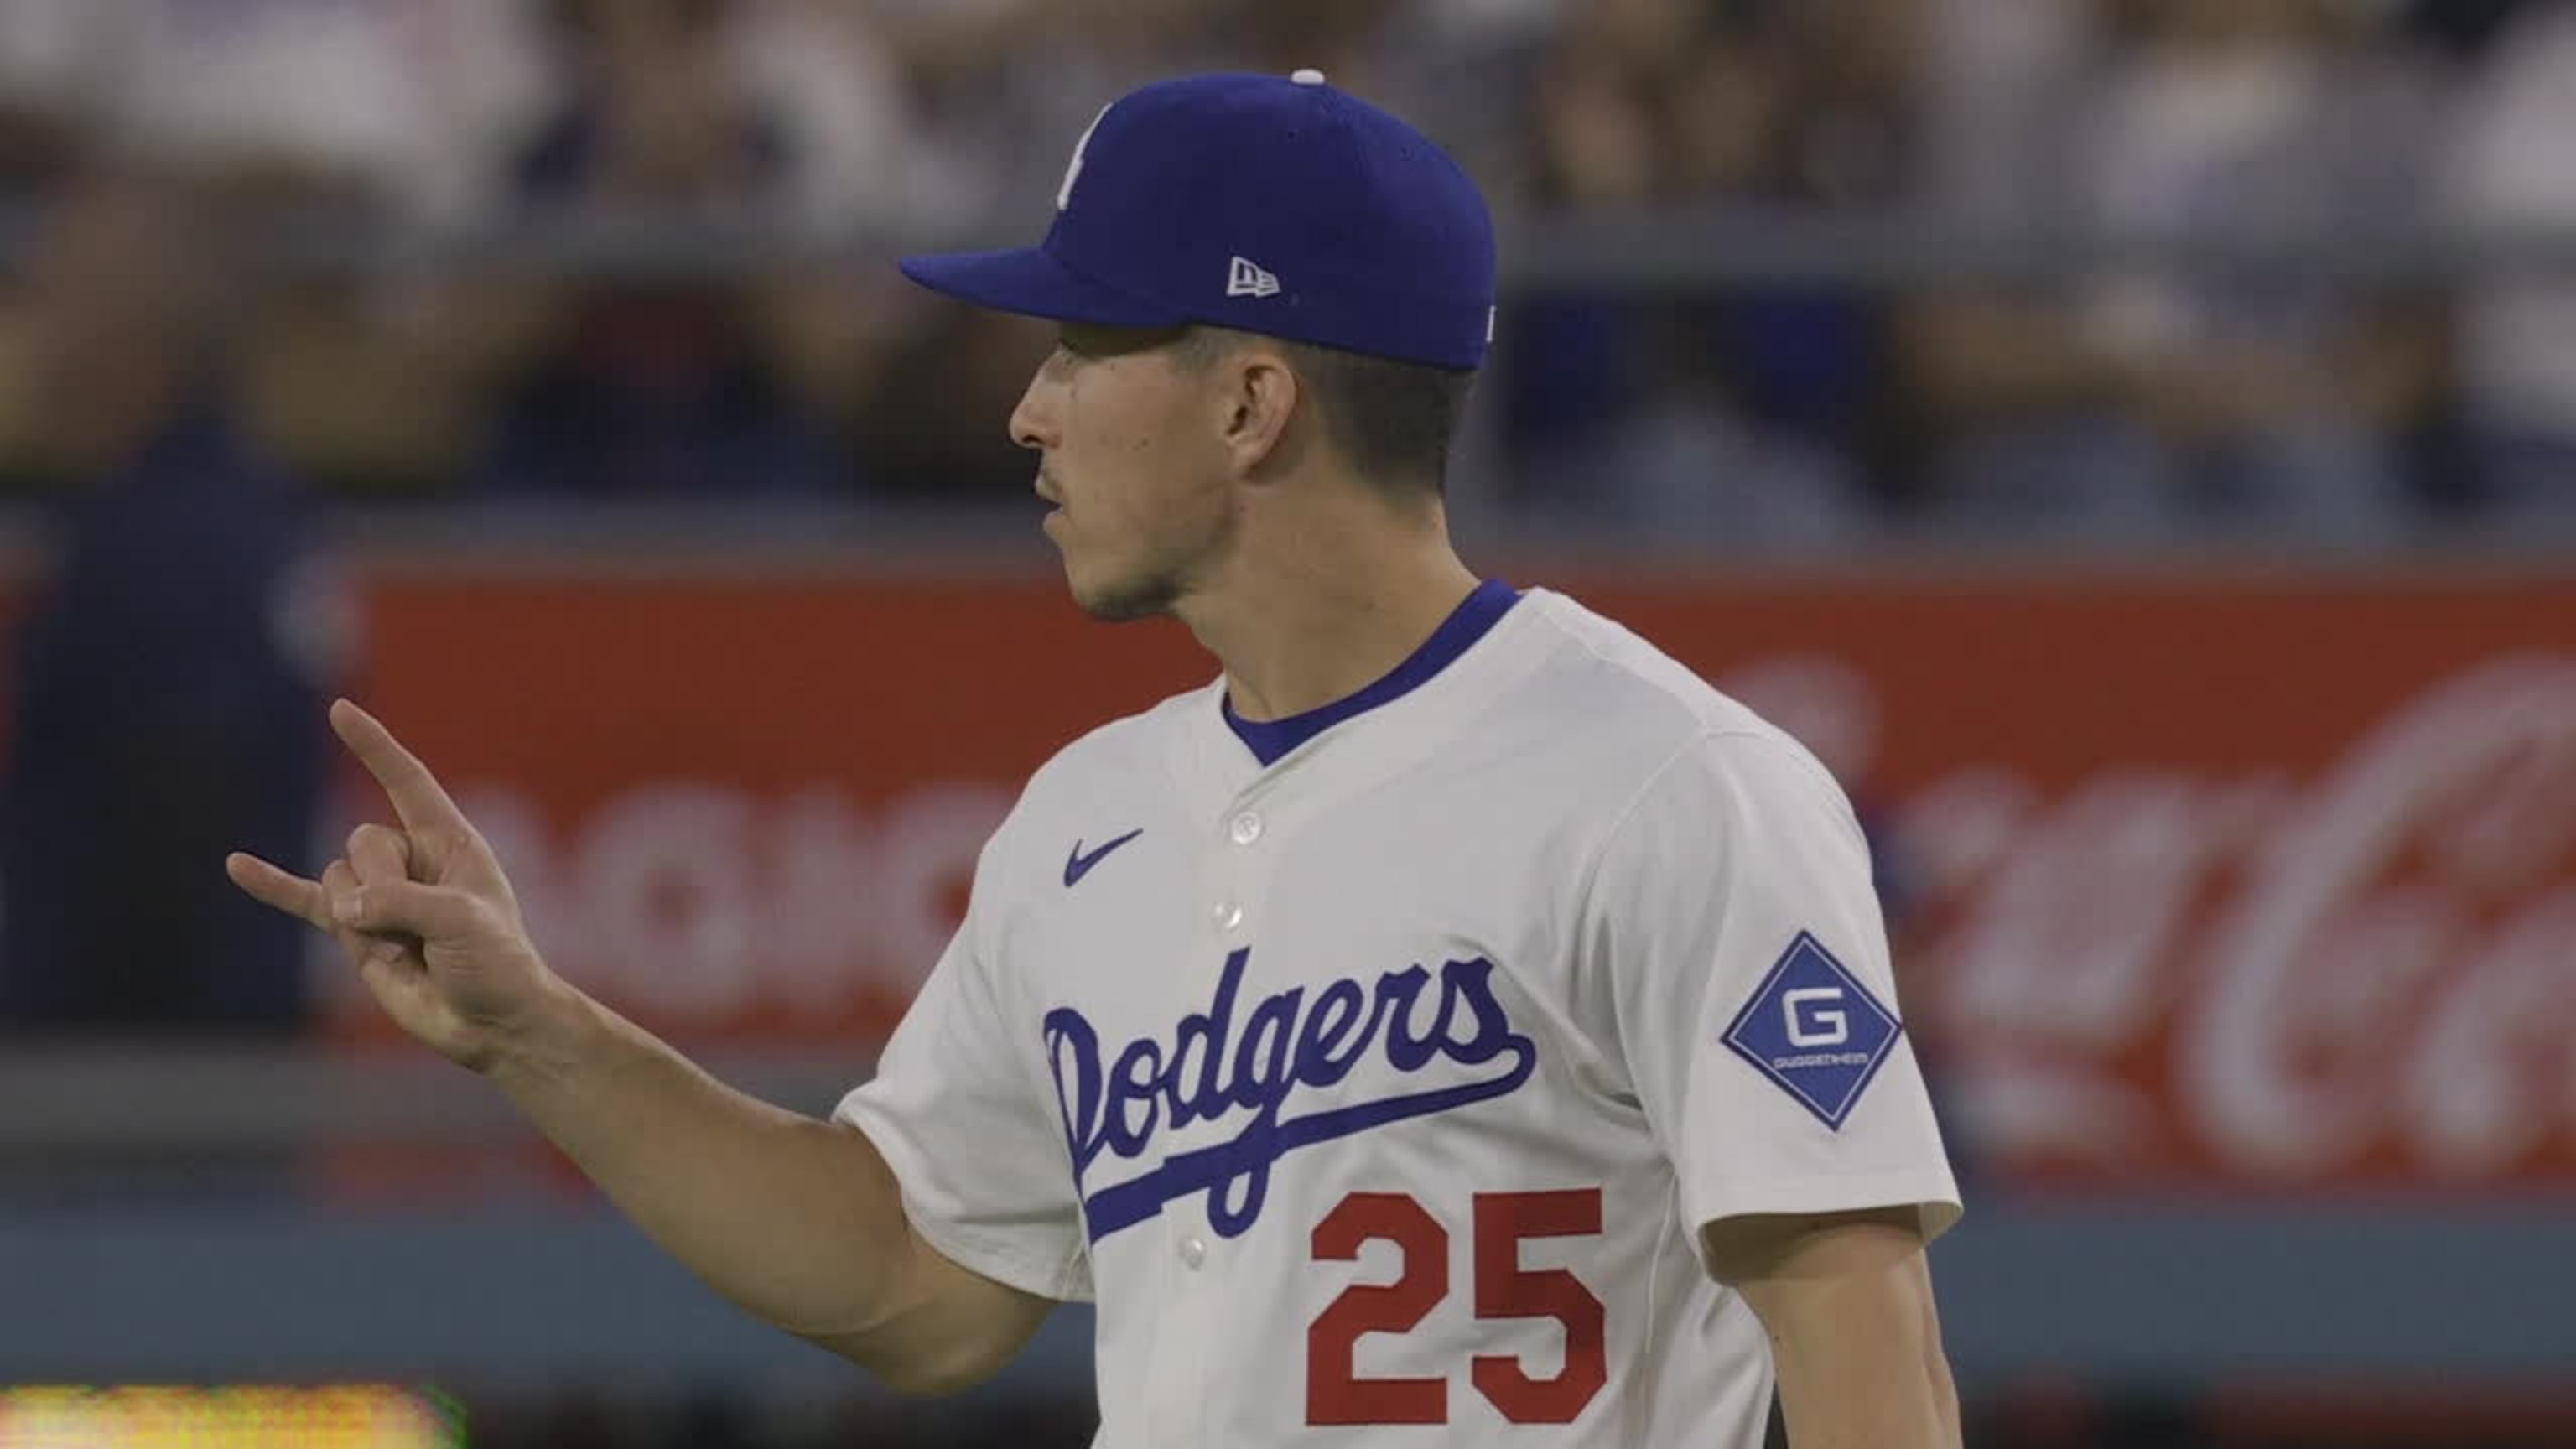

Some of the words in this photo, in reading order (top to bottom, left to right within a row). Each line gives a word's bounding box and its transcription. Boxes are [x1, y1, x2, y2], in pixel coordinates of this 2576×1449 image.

[1043, 945, 1536, 1246] Dodgers
[1782, 988, 1848, 1047] G
[1306, 1187, 1607, 1426] 25
